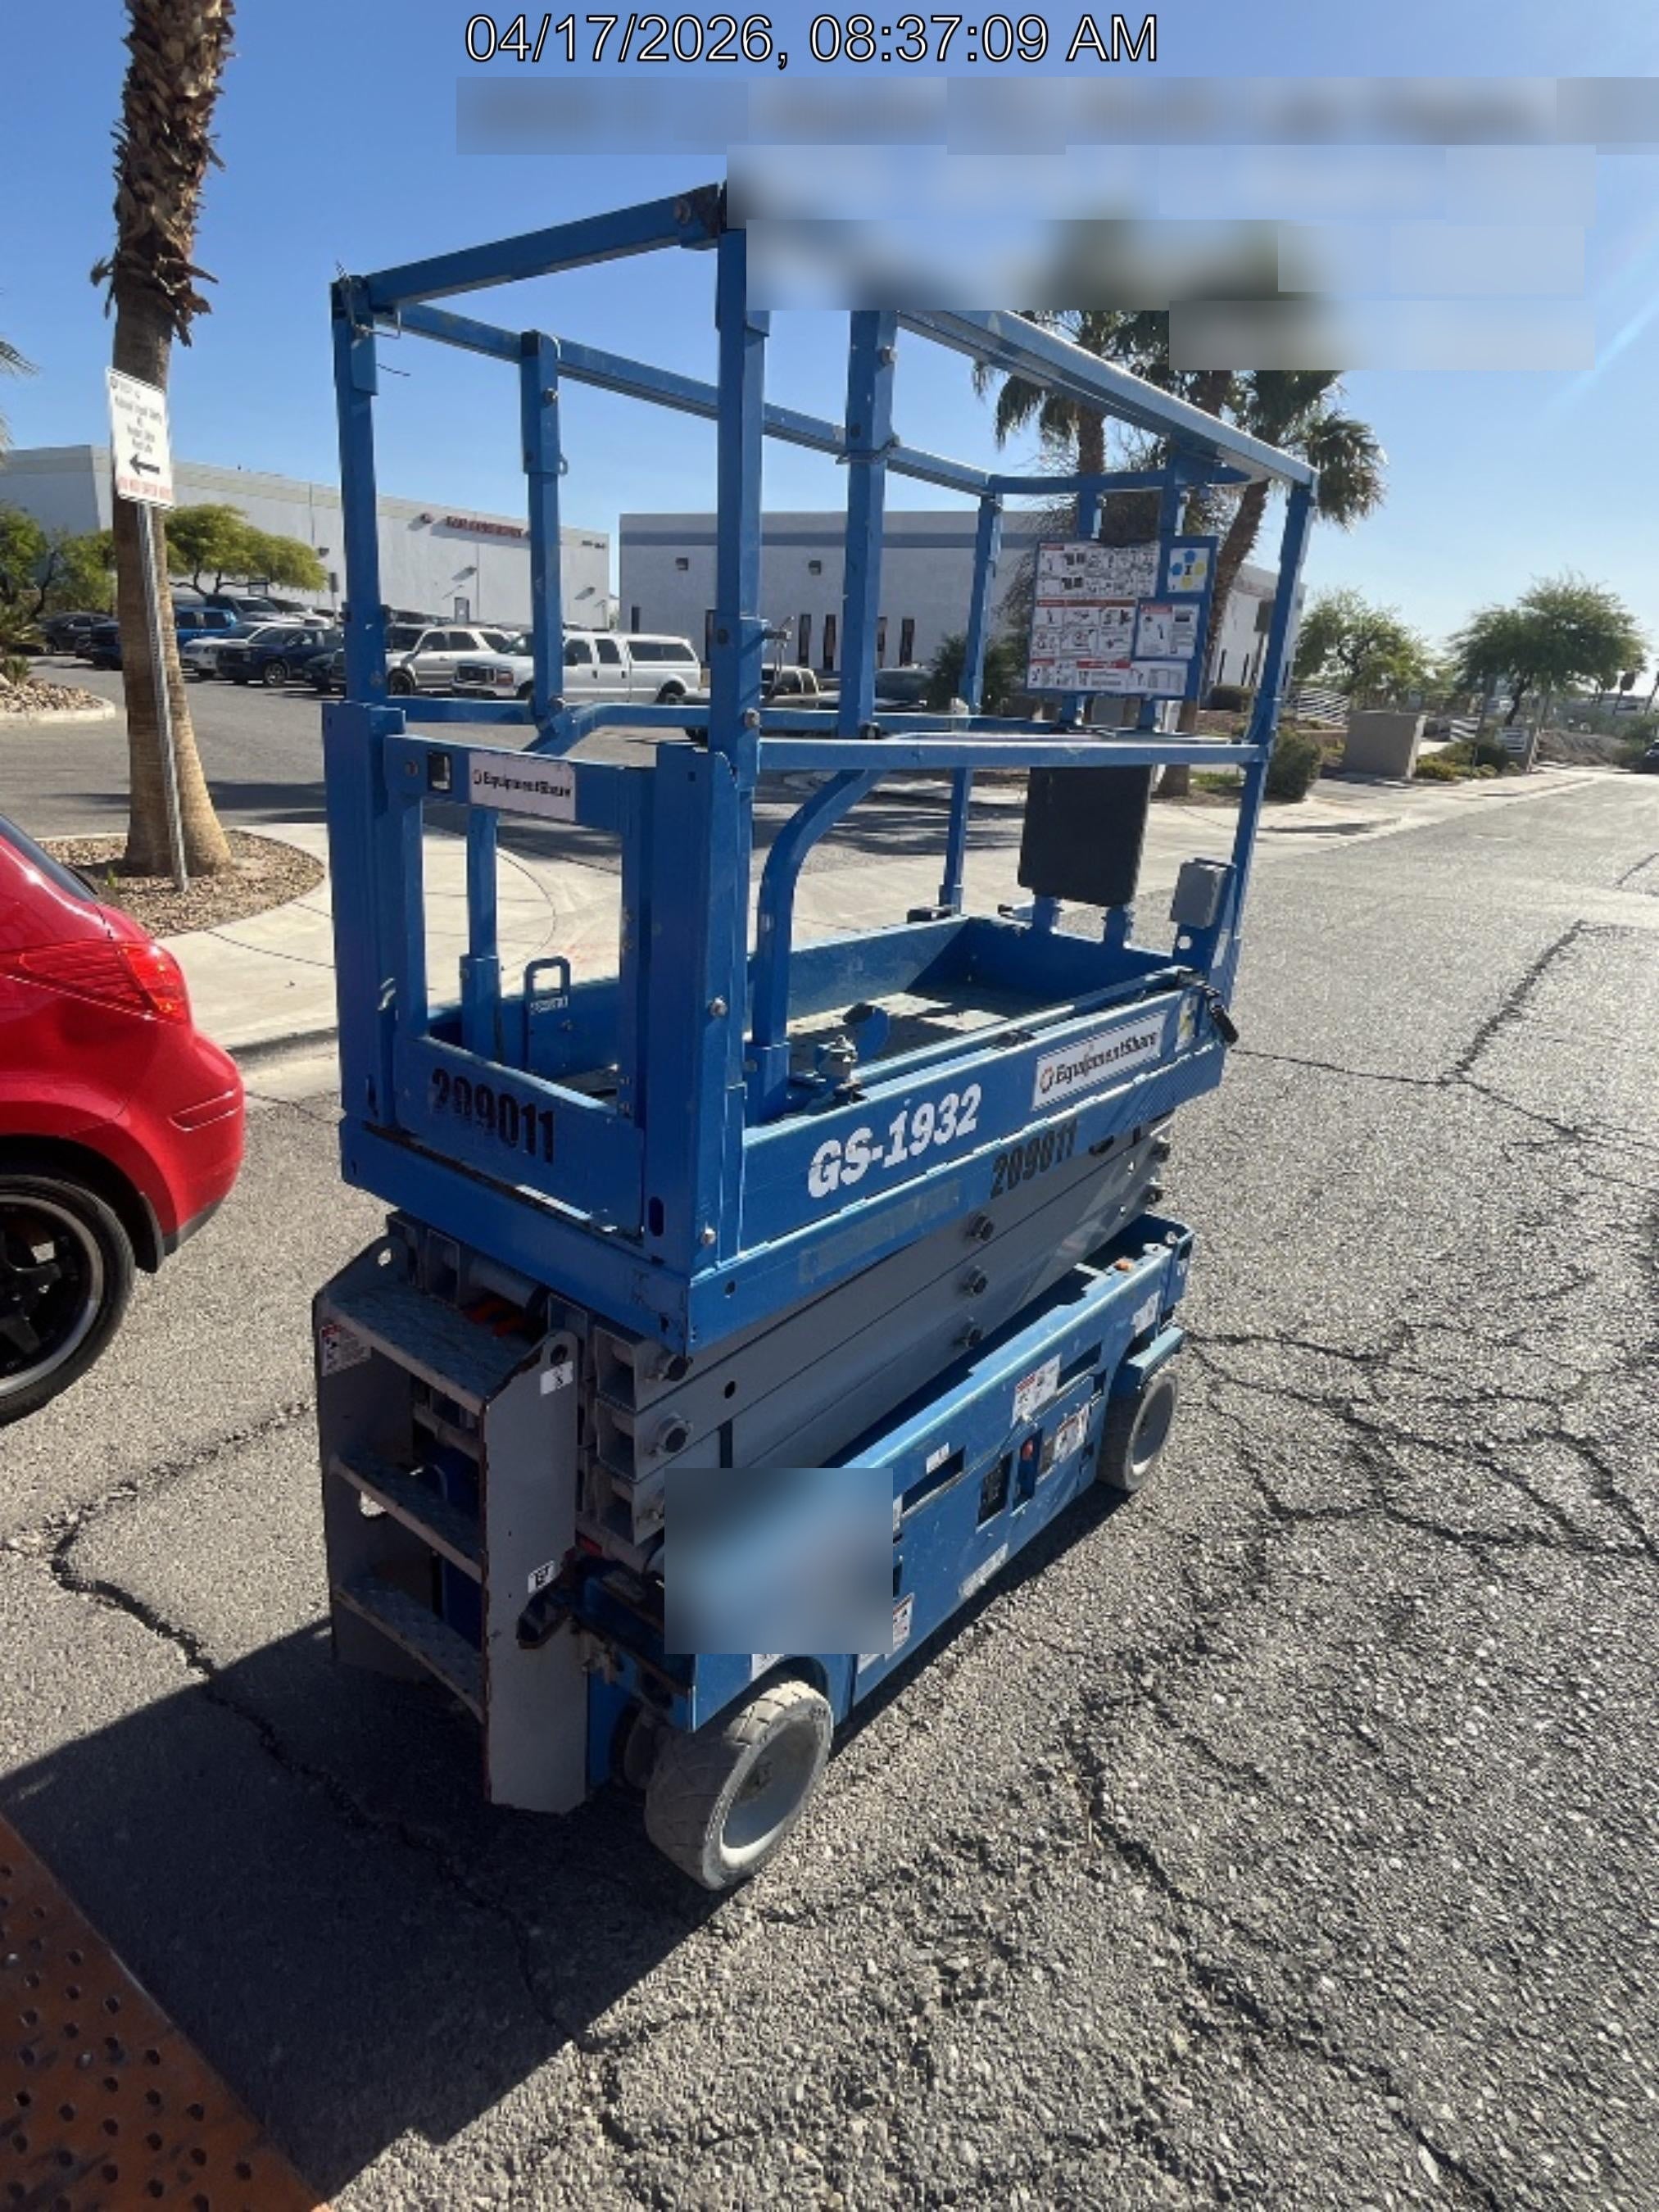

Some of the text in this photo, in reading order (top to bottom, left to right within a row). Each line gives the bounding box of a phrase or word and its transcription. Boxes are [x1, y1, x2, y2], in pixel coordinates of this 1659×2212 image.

[1055, 1031, 1160, 1085] EquipmentShare
[428, 1067, 555, 1165] 209011
[807, 1082, 982, 1198] GS-1932
[990, 1117, 1077, 1199] 209011
